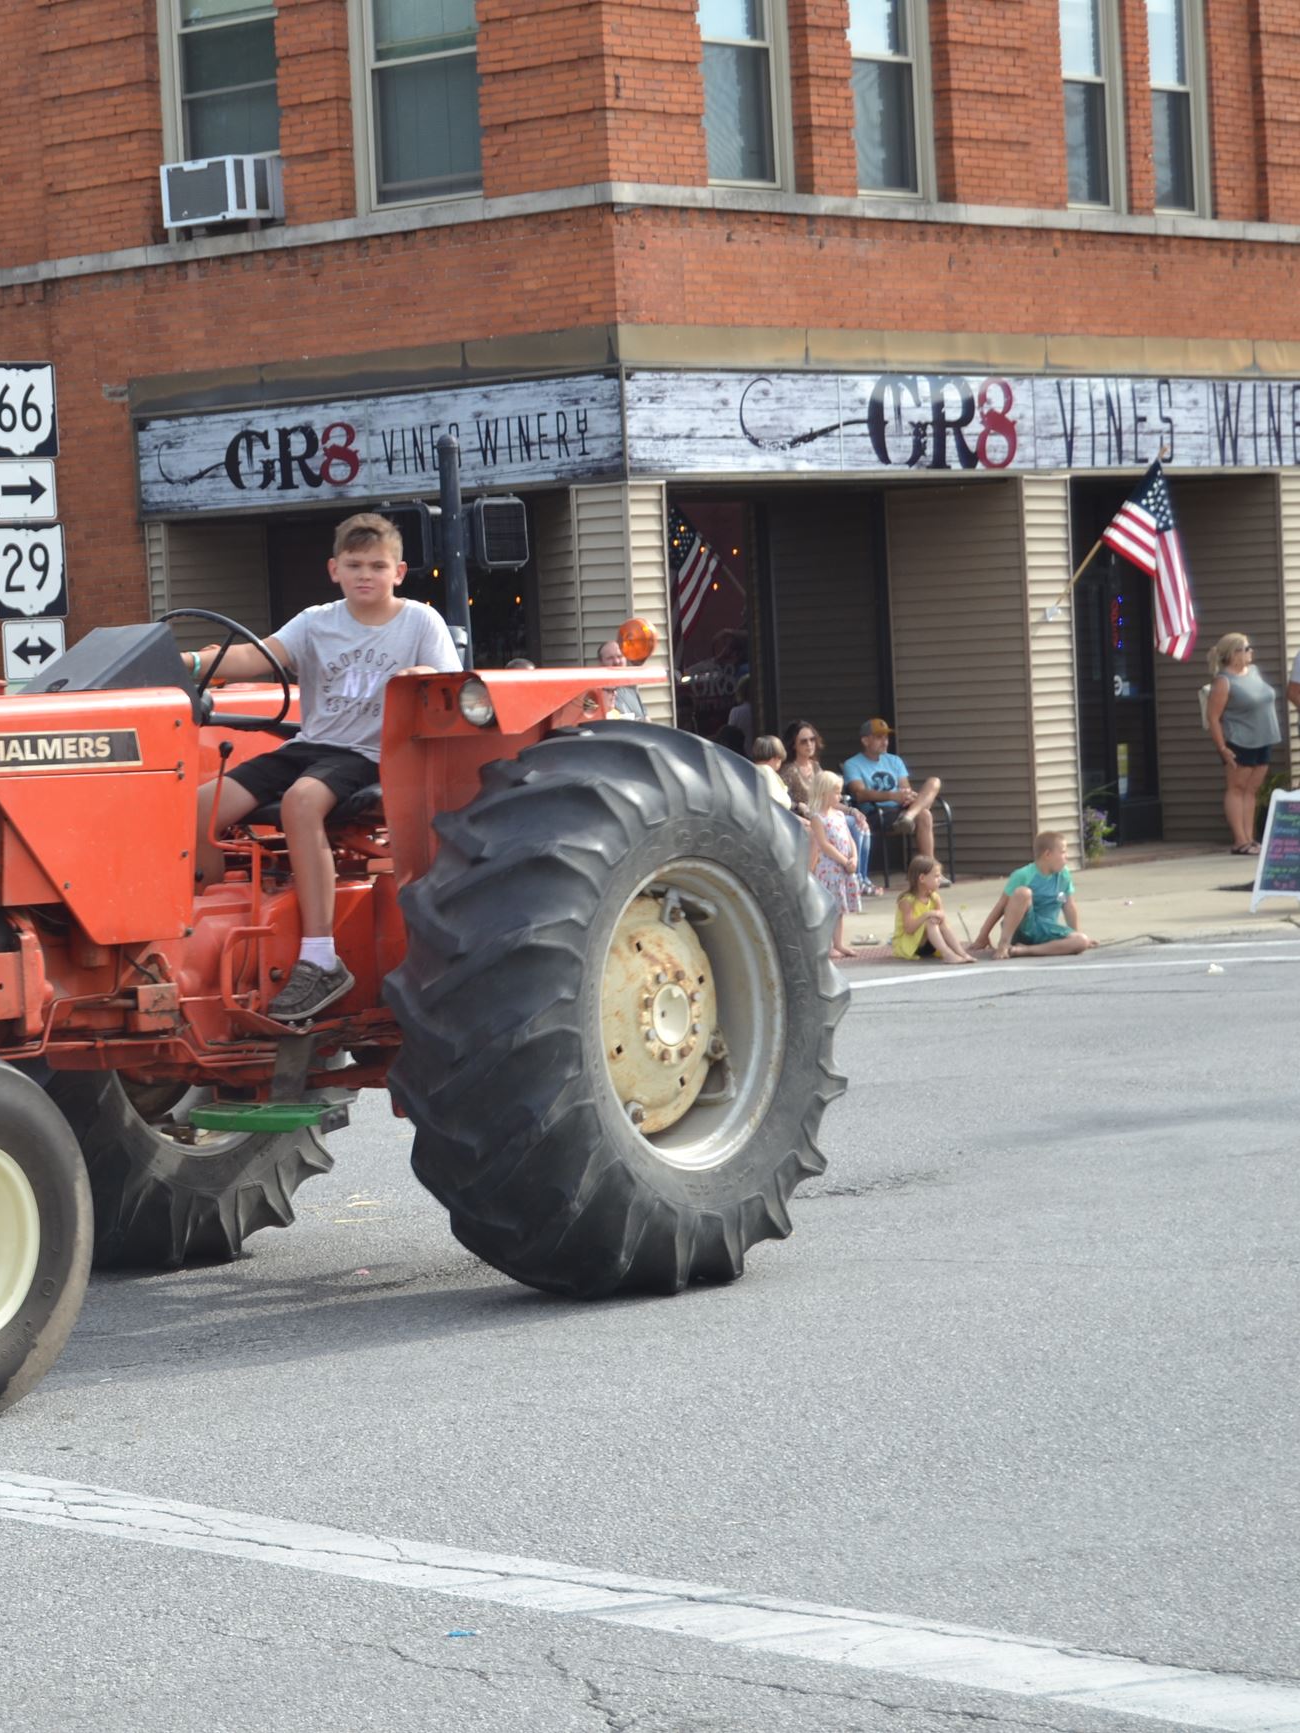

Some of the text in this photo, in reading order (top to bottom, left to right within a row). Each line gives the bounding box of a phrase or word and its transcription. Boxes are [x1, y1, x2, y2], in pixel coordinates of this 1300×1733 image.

[224, 420, 360, 491] GR8
[476, 407, 590, 467] WINERY
[867, 375, 1017, 469] GR8
[1056, 379, 1173, 467] VINES
[2, 542, 50, 593] 29
[341, 668, 383, 699] NY
